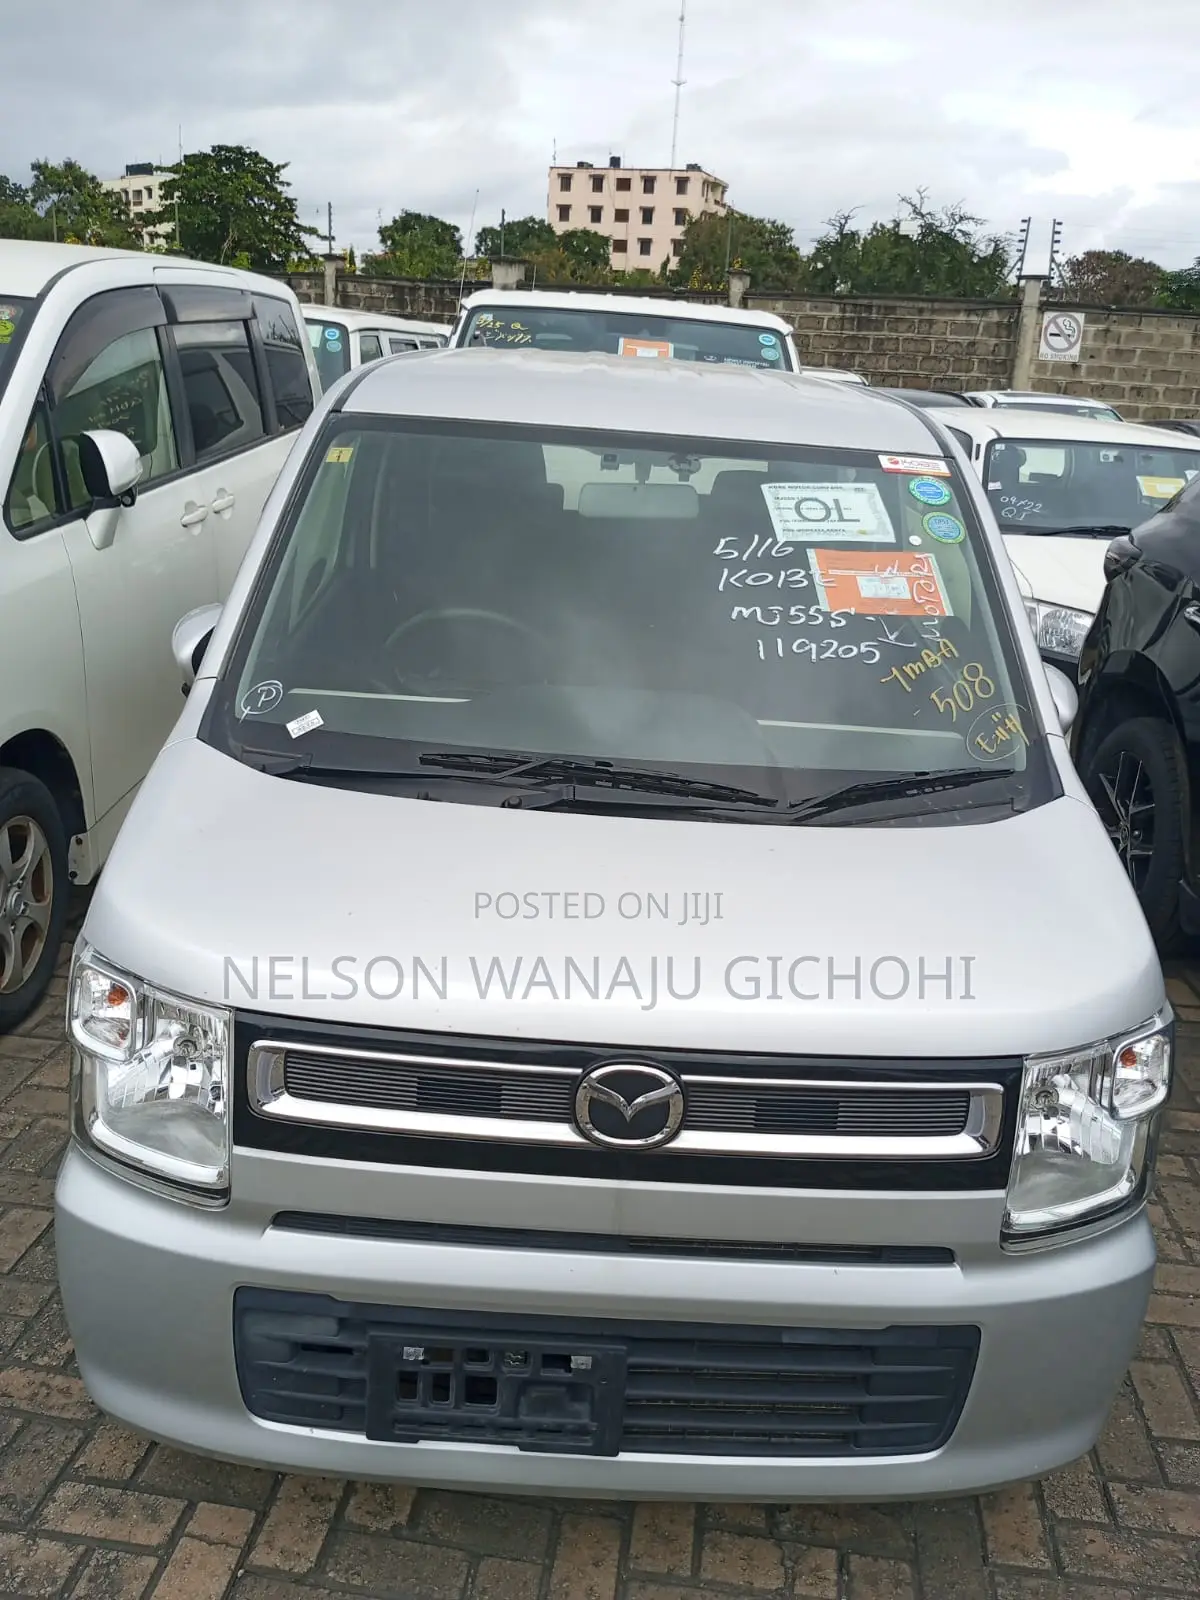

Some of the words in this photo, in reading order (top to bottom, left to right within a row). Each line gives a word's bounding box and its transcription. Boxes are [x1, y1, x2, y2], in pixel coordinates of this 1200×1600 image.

[794, 498, 860, 522] OL
[757, 637, 881, 664] 119205
[258, 686, 275, 708] P
[929, 662, 995, 722] 508
